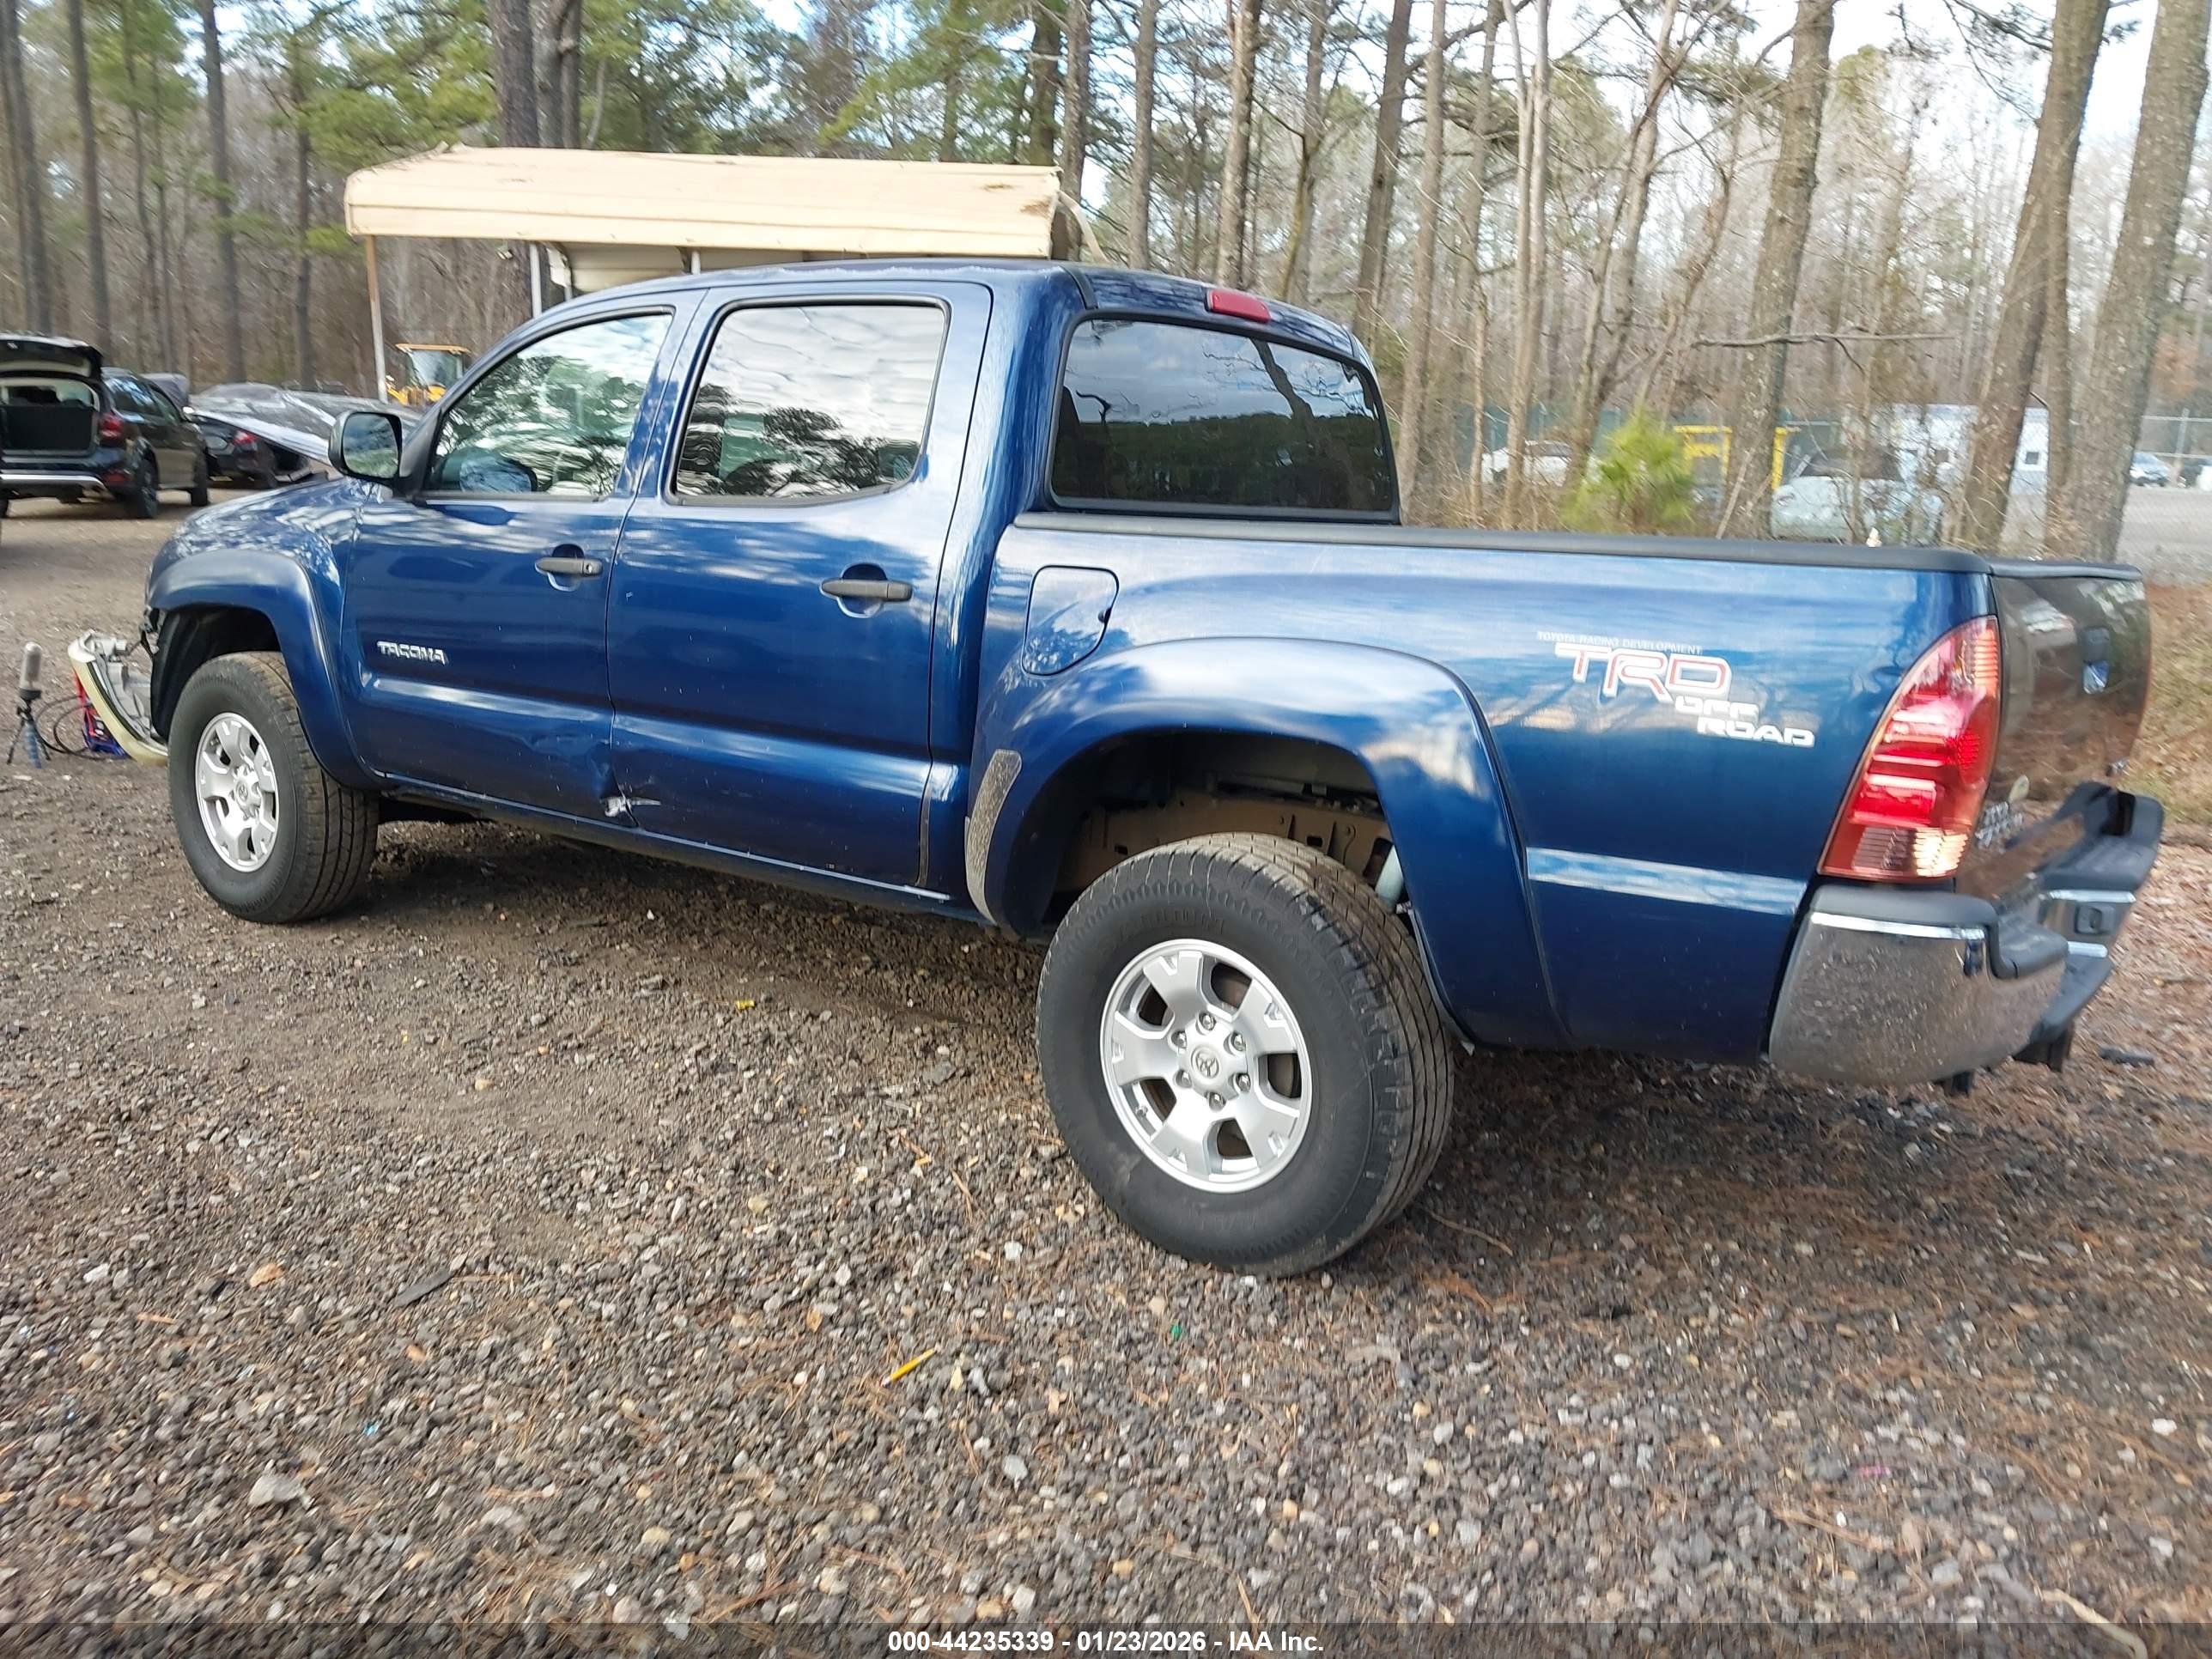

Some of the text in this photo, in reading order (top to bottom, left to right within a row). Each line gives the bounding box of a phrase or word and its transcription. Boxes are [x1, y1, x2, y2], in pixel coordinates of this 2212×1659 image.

[376, 641, 447, 665] TACOMA
[1537, 631, 1703, 655] TOYOTA RACING DEVELOPMENT
[1554, 642, 1732, 703] TRD
[1675, 695, 1759, 720] OFF
[1697, 716, 1815, 748] ROAD
